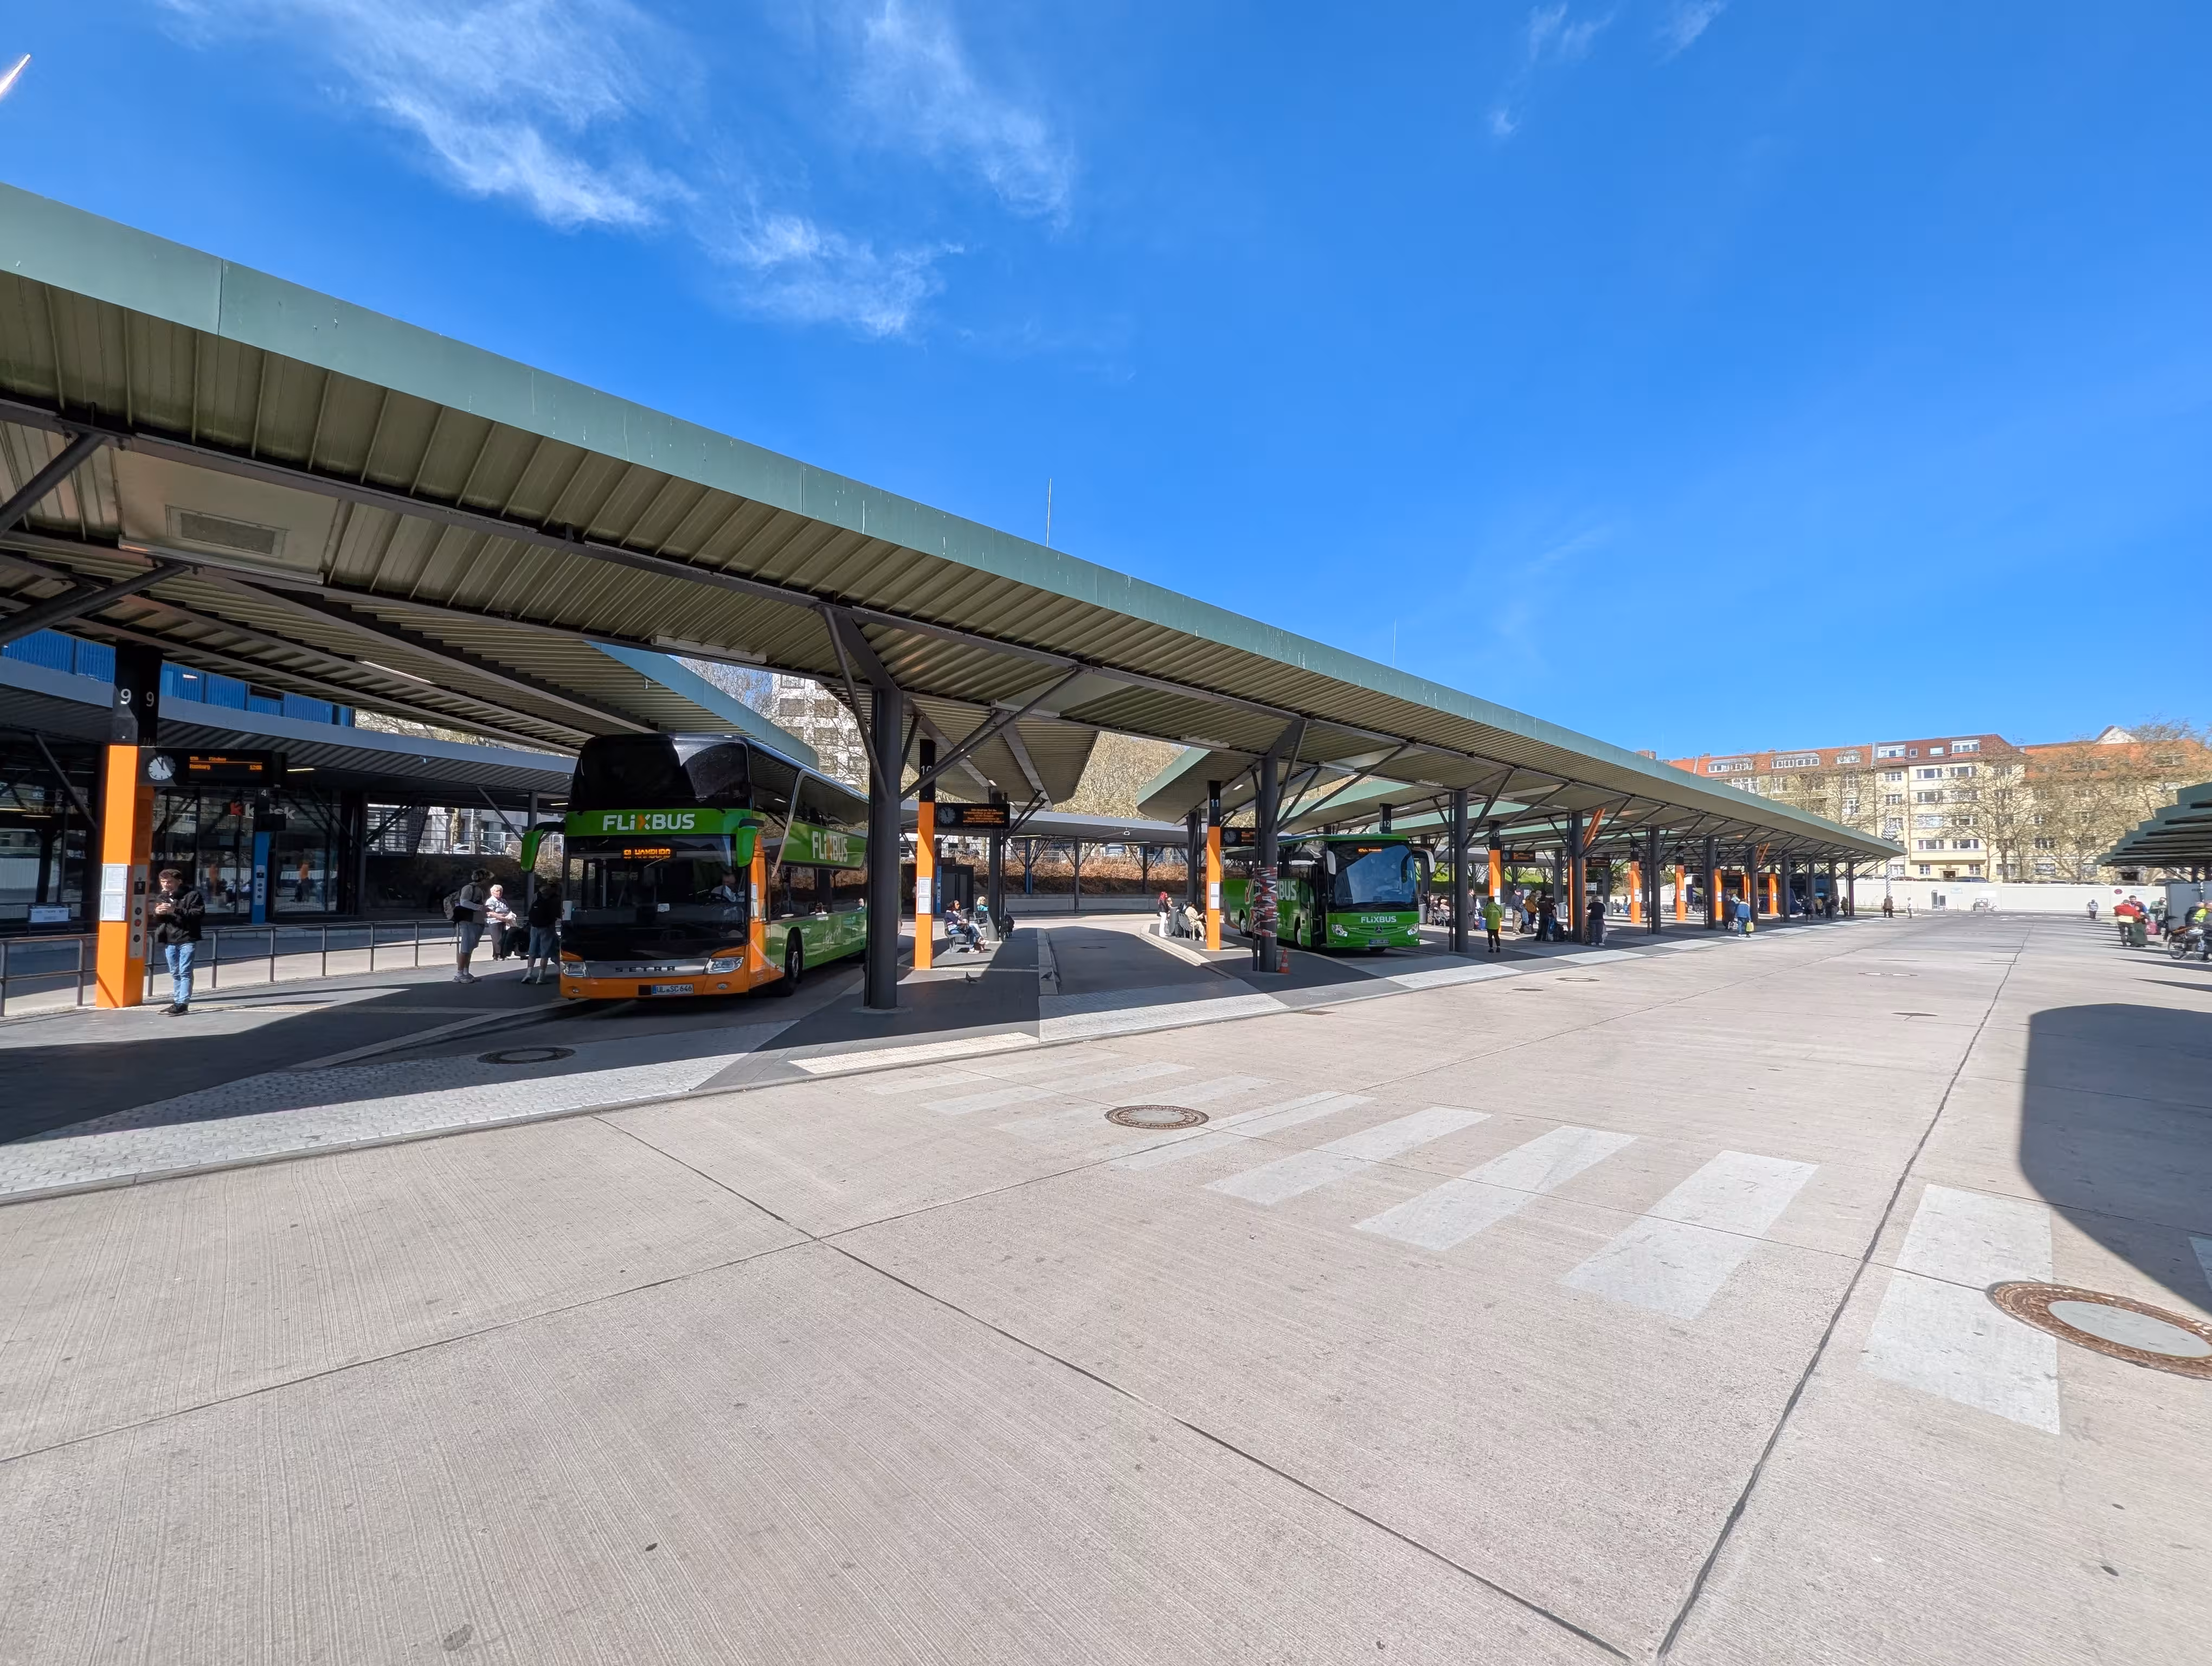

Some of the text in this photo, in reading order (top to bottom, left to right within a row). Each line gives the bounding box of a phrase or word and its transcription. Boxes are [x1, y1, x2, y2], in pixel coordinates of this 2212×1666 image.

[121, 688, 131, 704] 9
[146, 691, 154, 707] 9
[1211, 799, 1219, 807] 11
